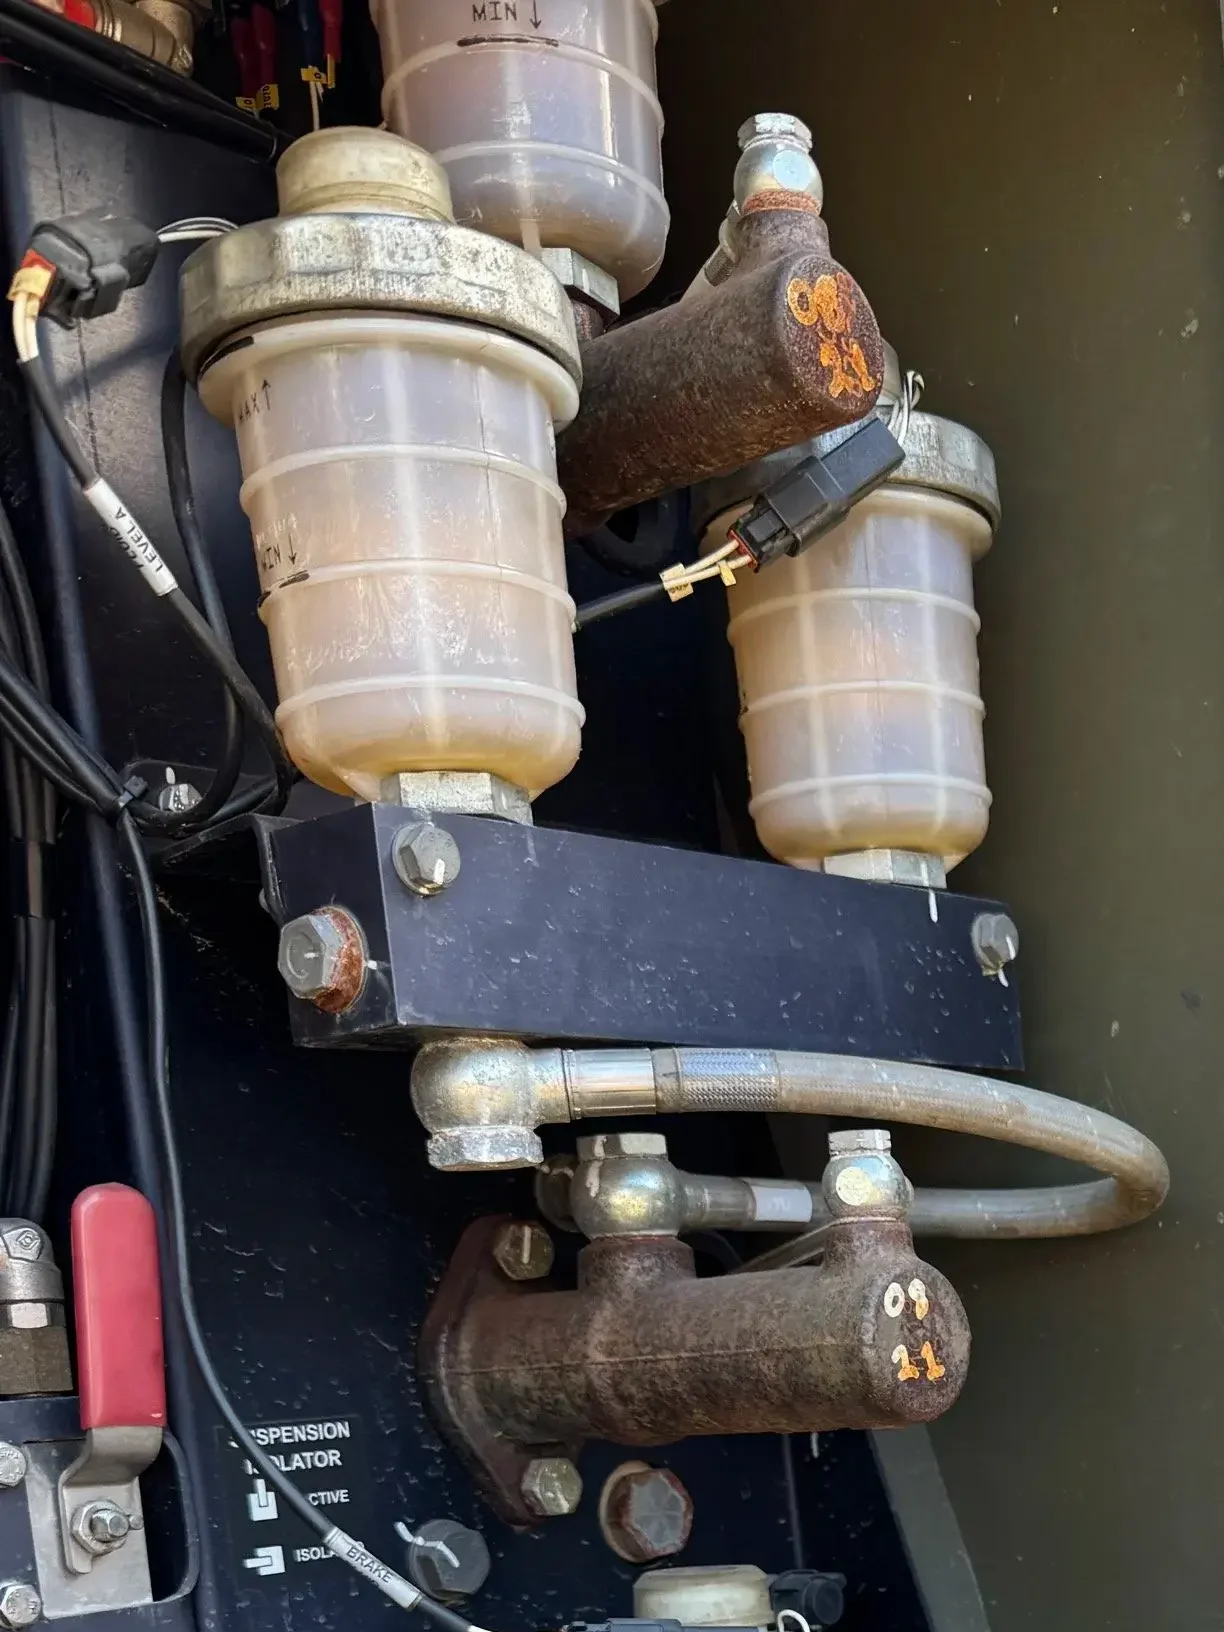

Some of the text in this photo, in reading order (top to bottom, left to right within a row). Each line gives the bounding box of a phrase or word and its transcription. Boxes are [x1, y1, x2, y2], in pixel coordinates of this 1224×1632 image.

[472, 1, 518, 22] MIN
[114, 506, 164, 573] LEVEL A
[228, 1420, 351, 1448] SPENSION
[306, 1489, 351, 1507] CTIVE
[346, 1545, 395, 1584] BRAKE
